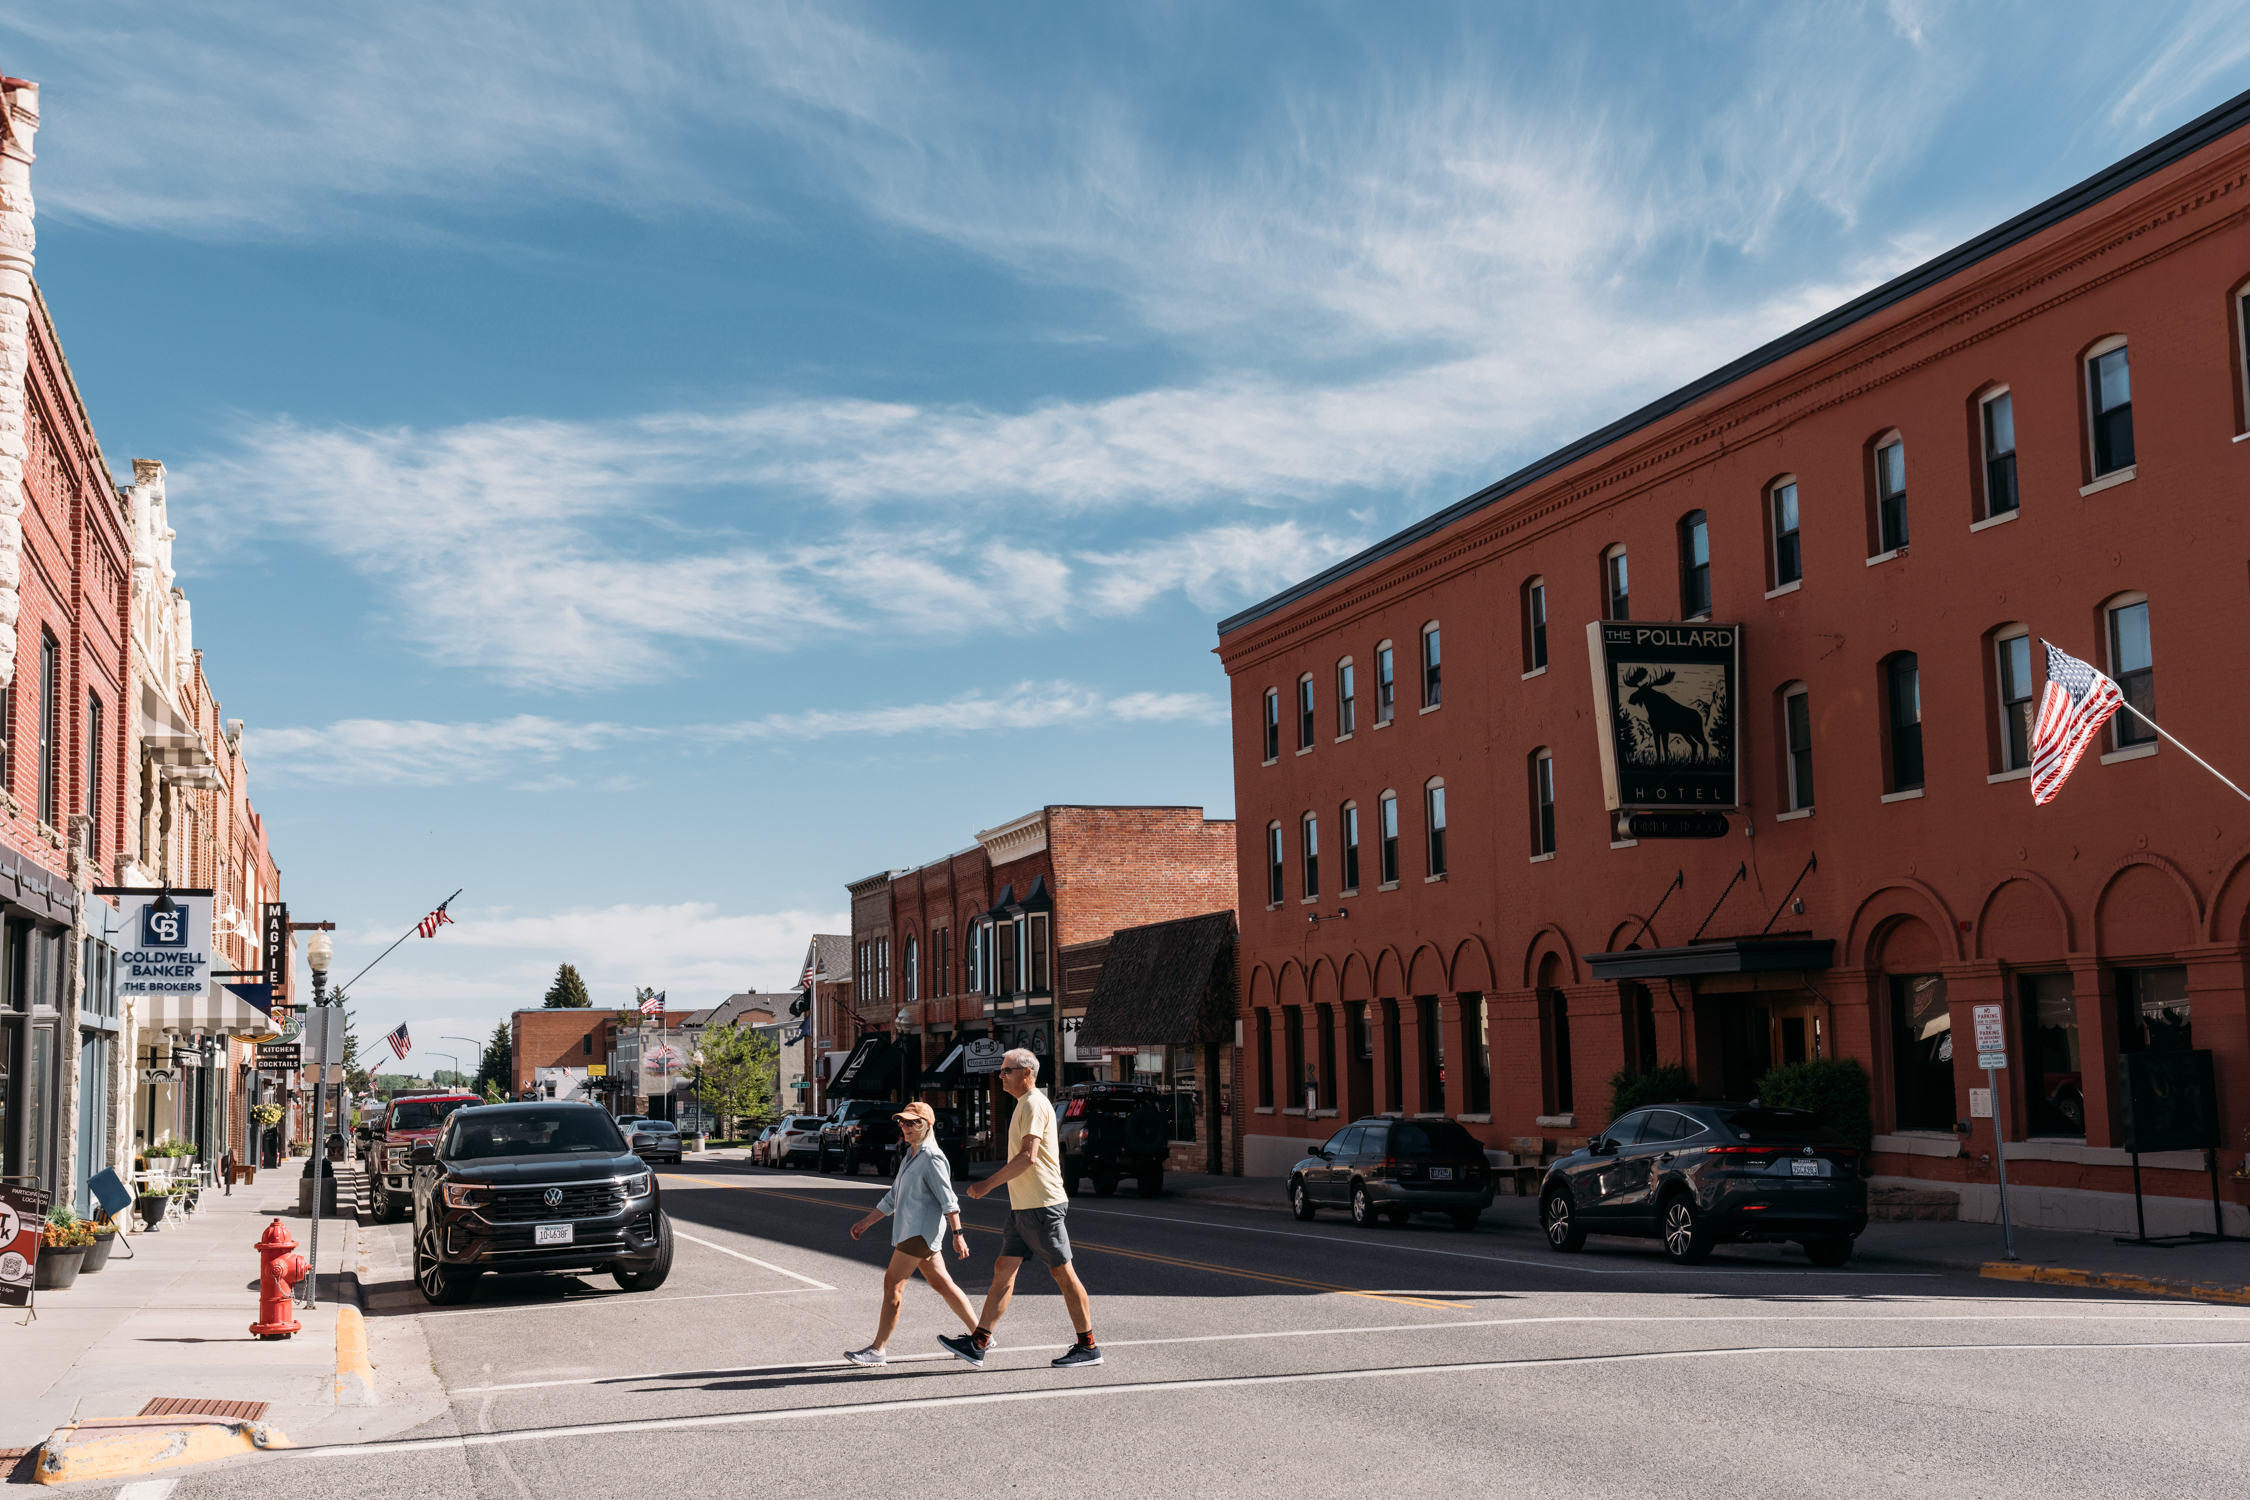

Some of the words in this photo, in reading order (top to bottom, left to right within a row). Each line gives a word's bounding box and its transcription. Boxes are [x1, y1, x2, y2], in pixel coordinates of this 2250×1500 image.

[1605, 630, 1632, 640] THE
[1636, 629, 1733, 648] POLLARD
[1635, 787, 1721, 800] HOTEL
[269, 905, 281, 983] MAGPIE
[122, 951, 206, 964] COLDWELL
[132, 965, 195, 977] BANKER
[124, 982, 146, 991] THE
[149, 982, 202, 992] BROKERS
[12, 1188, 49, 1199] PARTICIPAING
